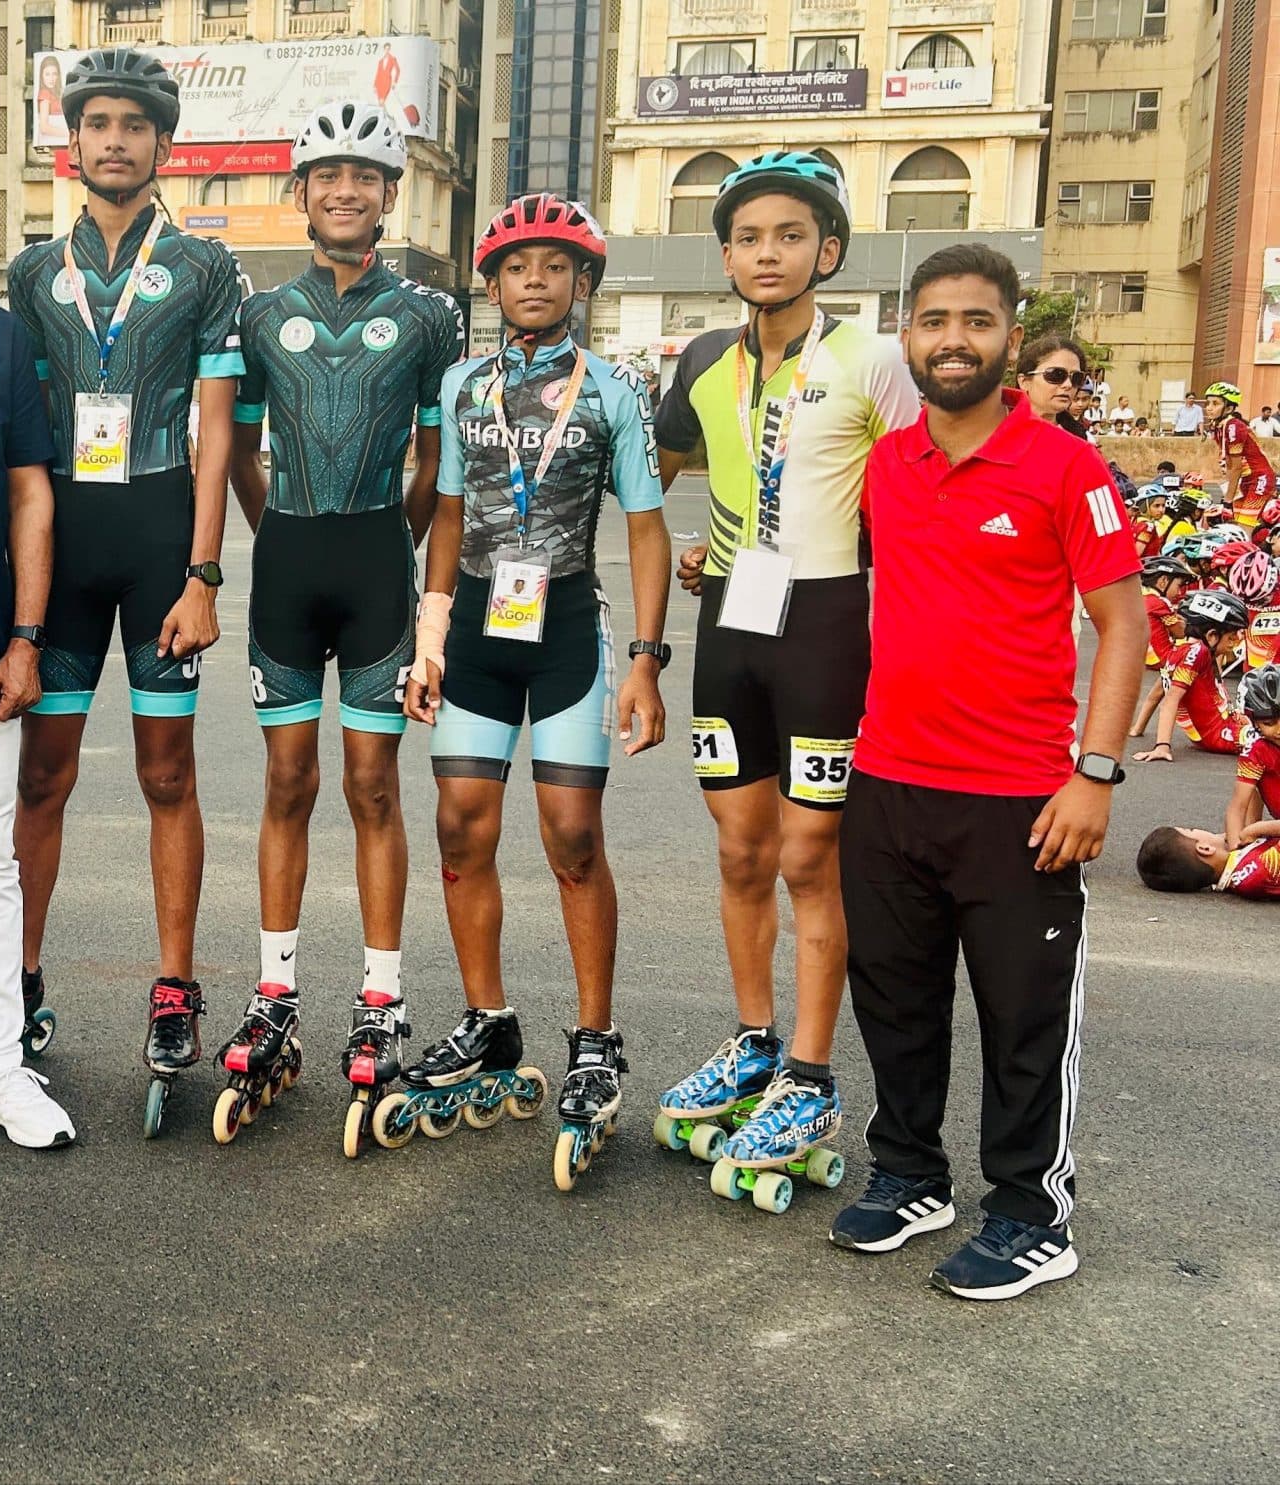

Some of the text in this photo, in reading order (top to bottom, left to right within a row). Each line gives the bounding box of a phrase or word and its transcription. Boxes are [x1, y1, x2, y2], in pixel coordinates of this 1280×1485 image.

[277, 44, 354, 59] 0832-2732936
[365, 43, 378, 55] 37
[910, 79, 962, 91] HDFC Life
[203, 90, 243, 98] TRAINING
[689, 92, 847, 107] THE NEW INDIA ASSURANCE CO. LTD.
[162, 156, 210, 168] tak life
[802, 389, 827, 403] UP
[89, 454, 118, 465] GOA
[980, 524, 1018, 537] adidas
[1198, 599, 1223, 613] 379
[505, 610, 534, 622] GOA
[1255, 617, 1280, 628] 473
[805, 755, 853, 783] 35
